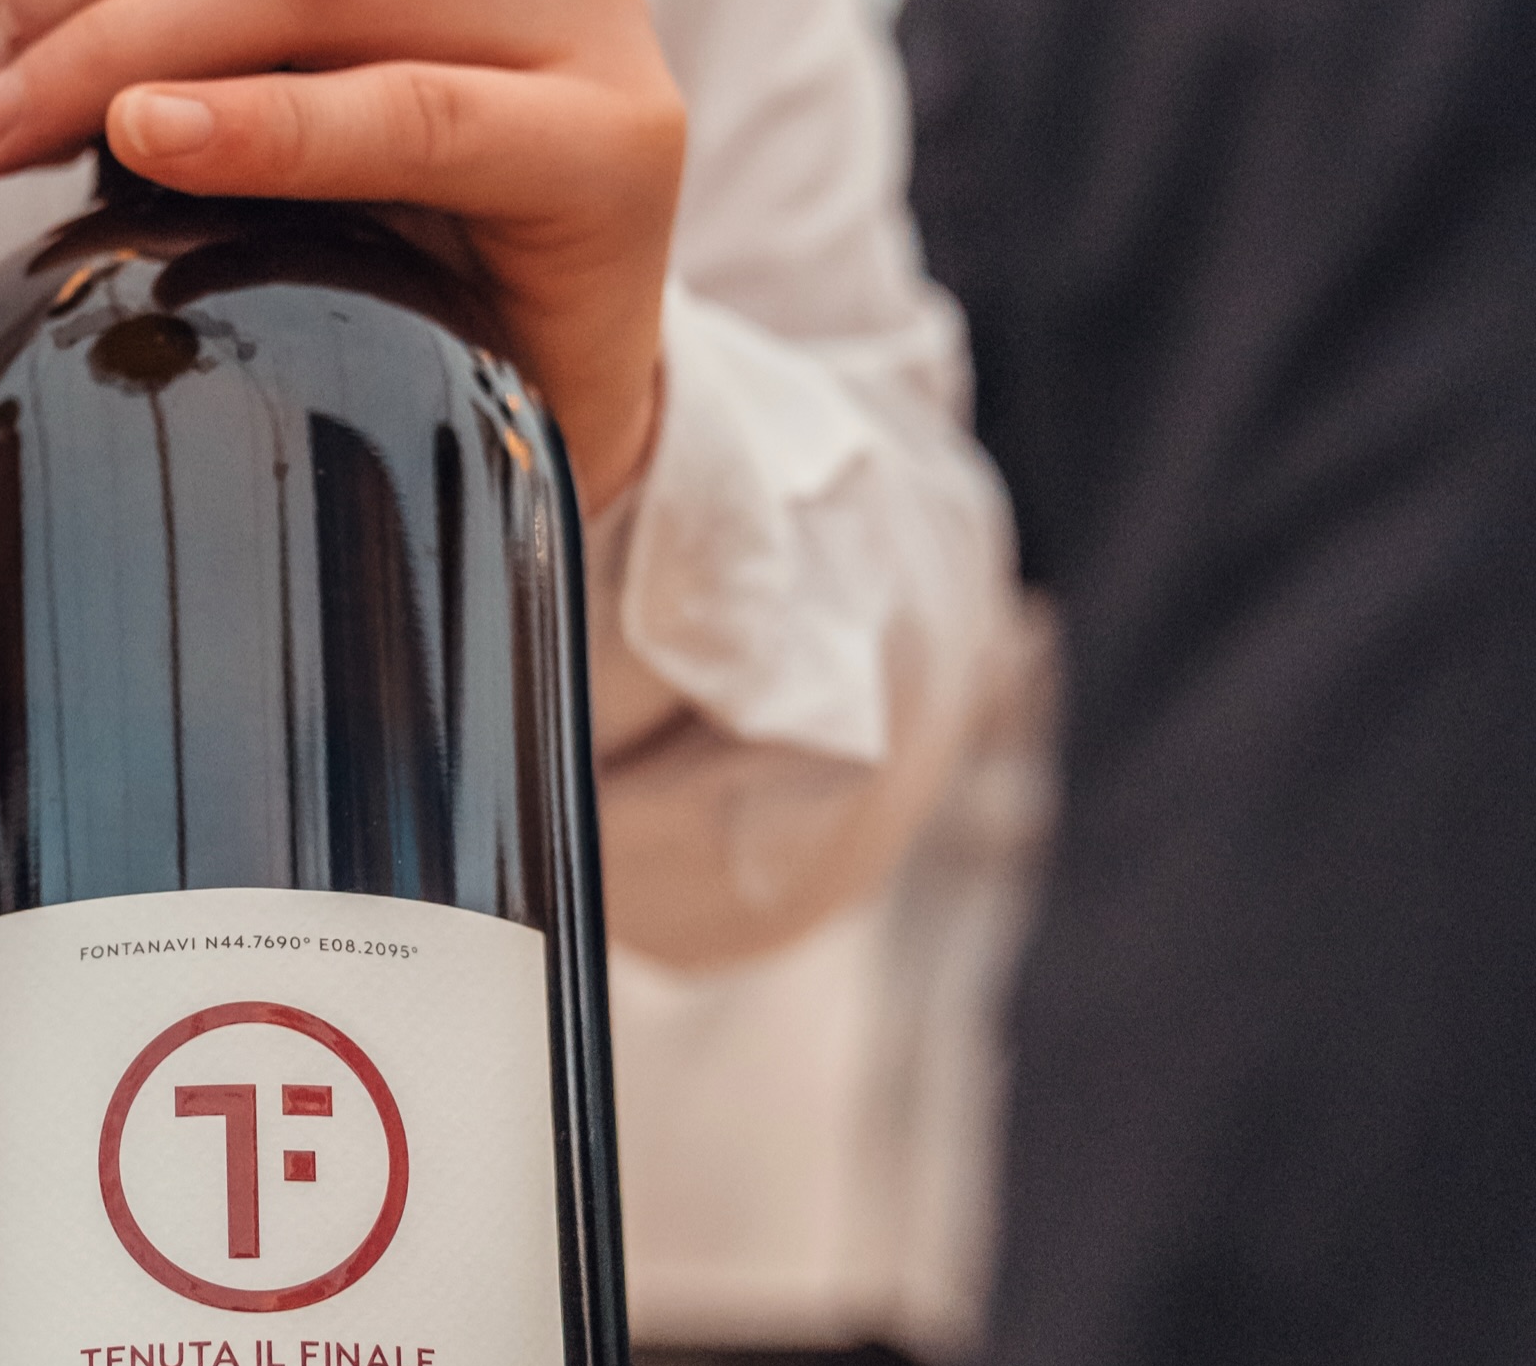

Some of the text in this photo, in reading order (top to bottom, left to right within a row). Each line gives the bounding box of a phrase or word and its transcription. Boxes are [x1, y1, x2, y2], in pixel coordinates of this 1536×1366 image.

[80, 935, 418, 960] FONTANAVI N44.7690° E08.2095°
